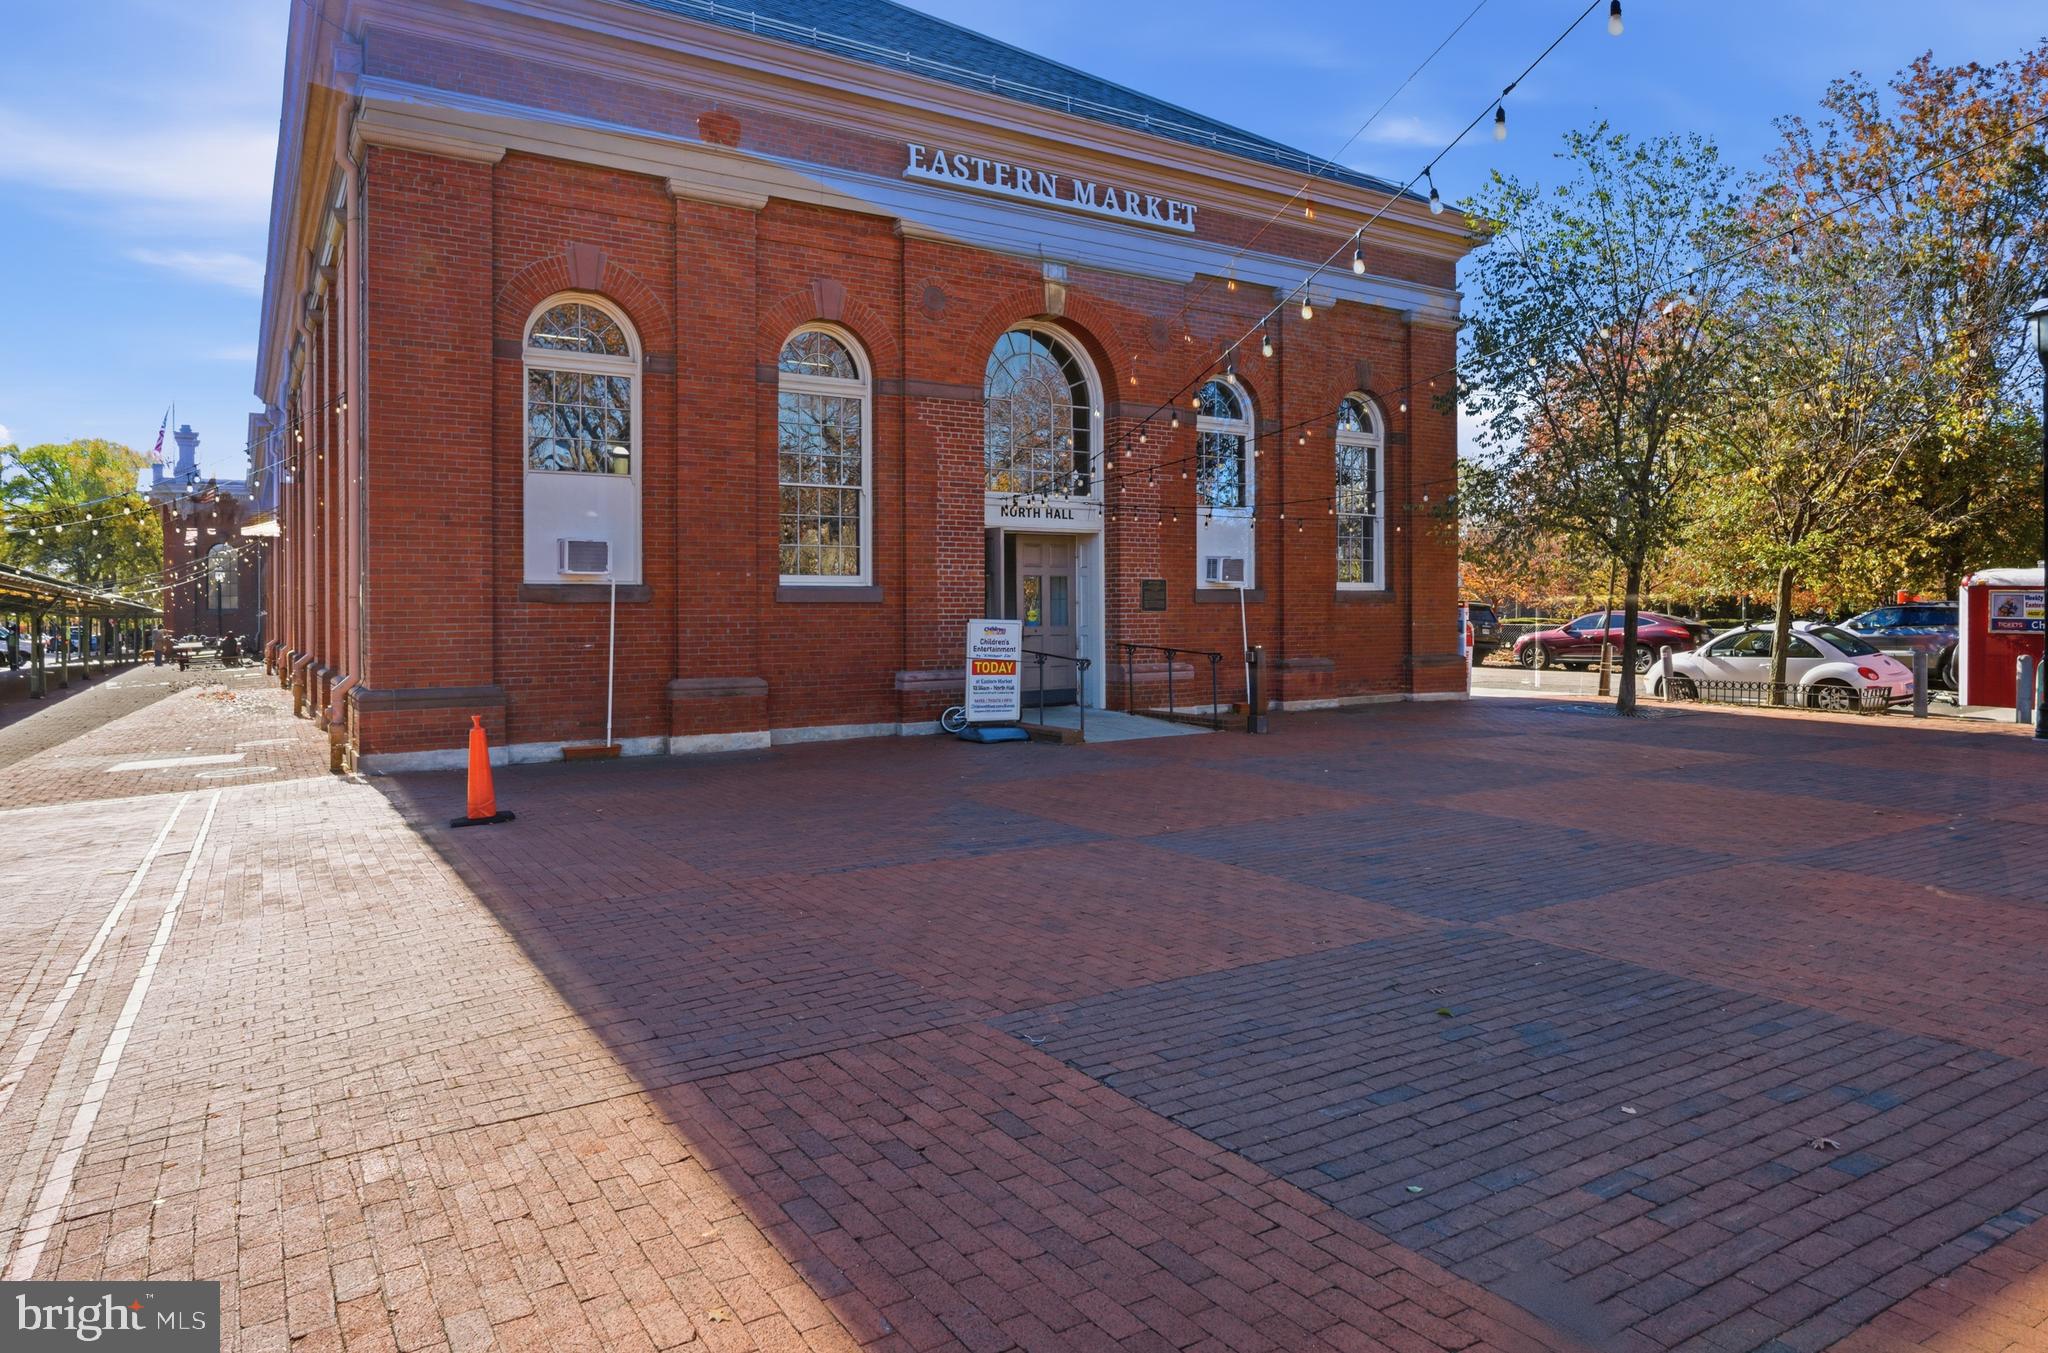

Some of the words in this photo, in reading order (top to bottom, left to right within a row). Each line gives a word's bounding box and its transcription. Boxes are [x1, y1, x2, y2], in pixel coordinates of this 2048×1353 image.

[907, 143, 1058, 198] EASTERN
[1072, 178, 1198, 228] MARKET
[1001, 506, 1040, 518] NORTH
[1046, 508, 1074, 520] HALL
[980, 638, 1010, 646] Children's
[973, 645, 1016, 653] Entertainment
[974, 661, 1014, 674] TODAY
